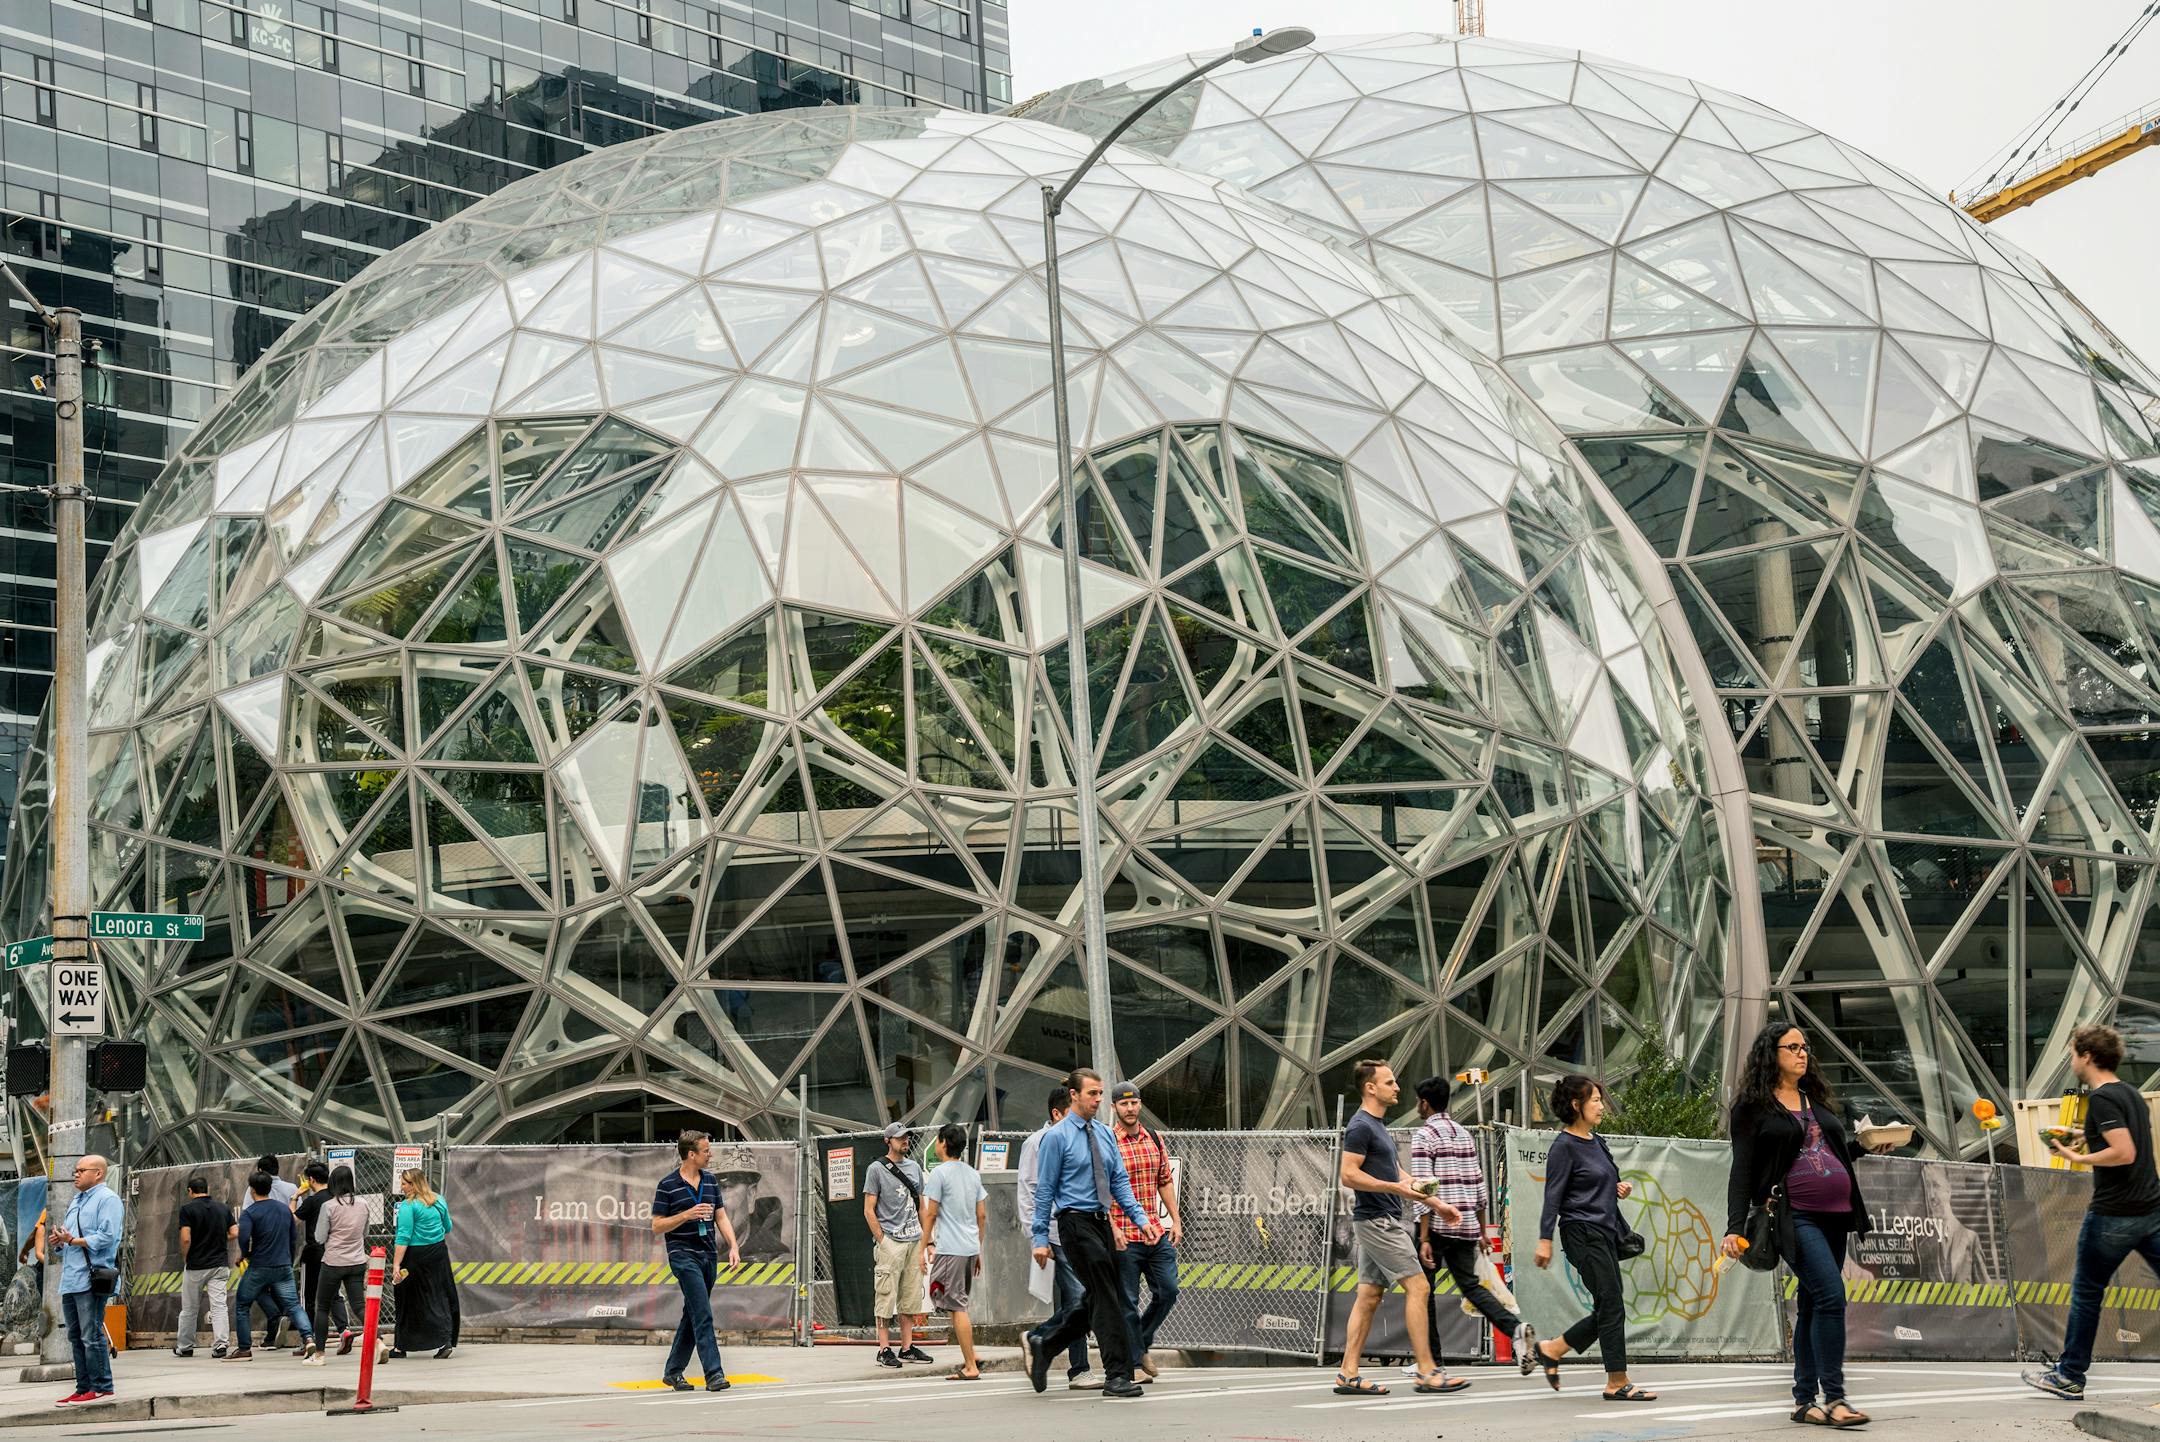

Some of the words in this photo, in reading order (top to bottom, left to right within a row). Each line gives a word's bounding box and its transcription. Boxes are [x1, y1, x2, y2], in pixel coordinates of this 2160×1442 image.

[95, 914, 153, 935] Lenora
[166, 923, 179, 936] St
[184, 917, 202, 925] 2100
[9, 945, 24, 965] 6th
[41, 943, 54, 956] Ave
[59, 970, 98, 986] ONE
[58, 990, 99, 1005] WAY
[1518, 1150, 1536, 1162] THE
[534, 1196, 543, 1220] I
[549, 1201, 588, 1220] am
[1201, 1187, 1212, 1214] I
[1217, 1194, 1259, 1214] am
[1856, 1239, 1877, 1251] JOHN
[1861, 1253, 1915, 1264] CONSTRUCTION
[1882, 1265, 1900, 1276] CO.
[1265, 1319, 1297, 1328] Sellen
